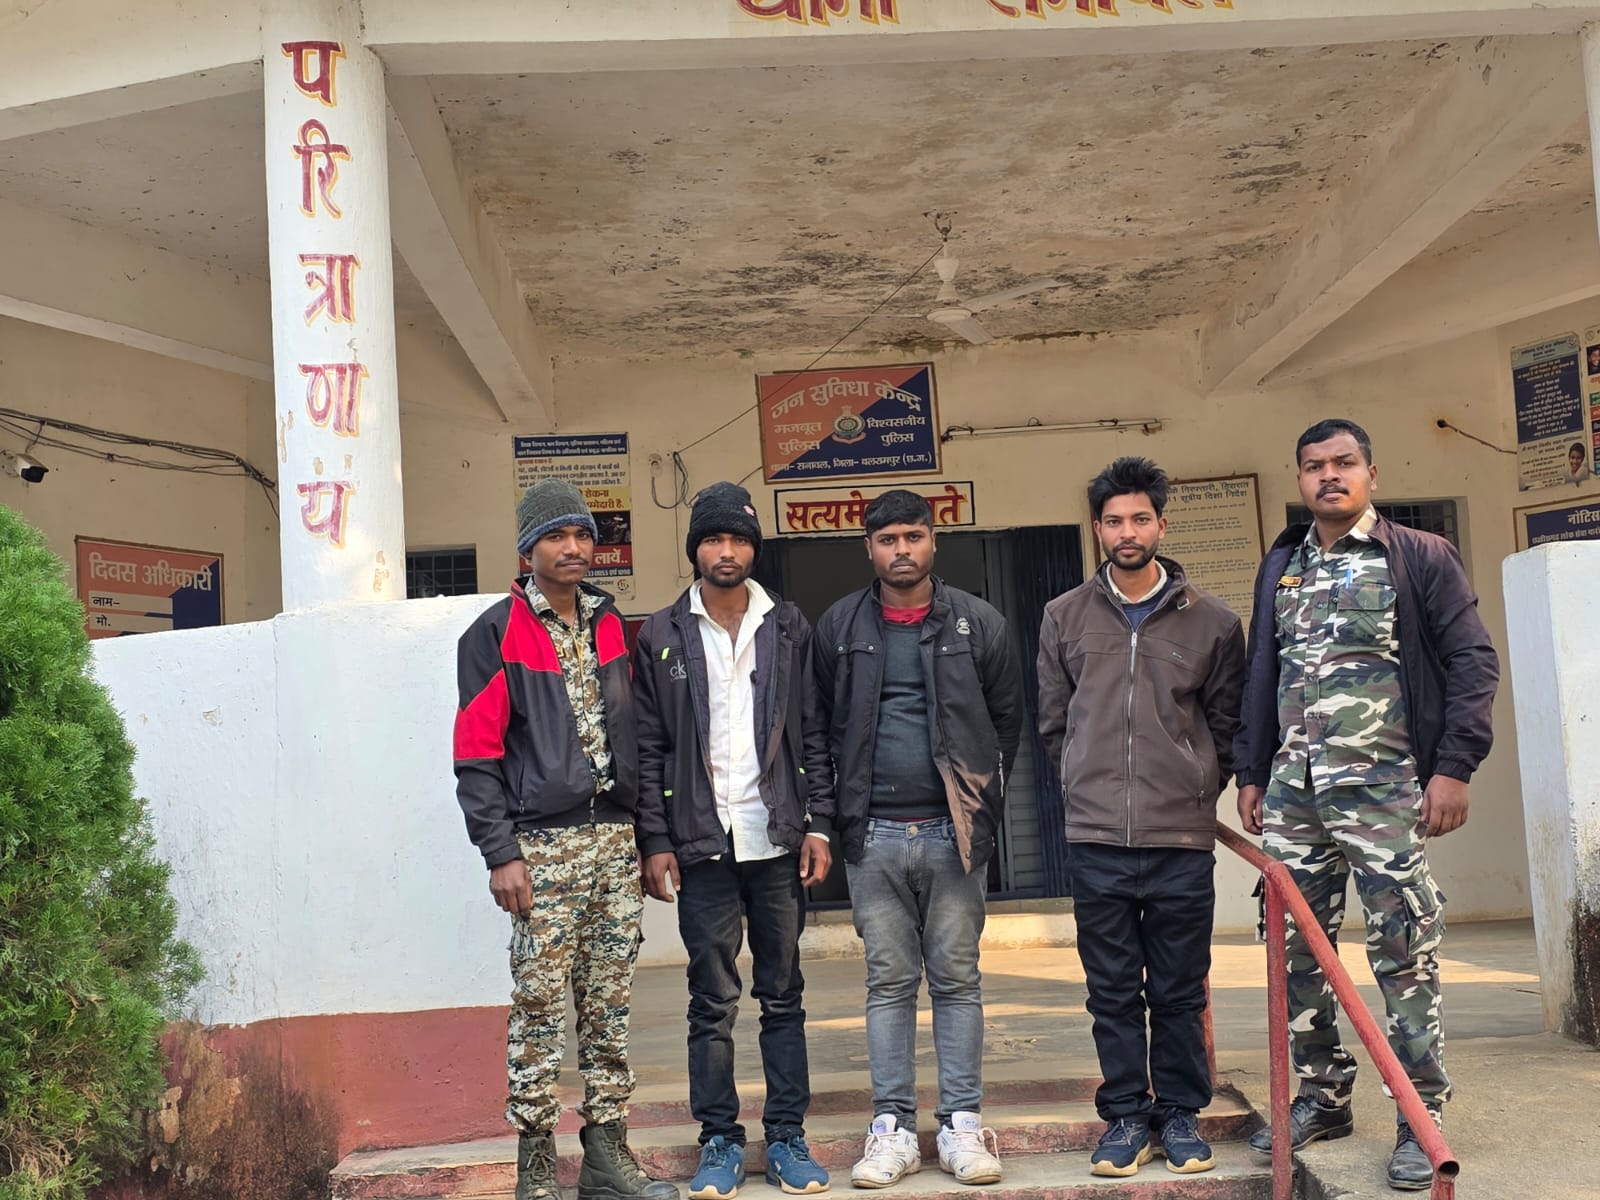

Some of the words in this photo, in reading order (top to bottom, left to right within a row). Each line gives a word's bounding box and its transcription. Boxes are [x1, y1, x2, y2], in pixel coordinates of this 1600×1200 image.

[771, 389, 806, 420] जन
[809, 376, 870, 407] सुविधा
[873, 379, 922, 412] केन्द्र
[866, 415, 926, 429] विश्वसनीय
[777, 440, 821, 456] पुलिस
[880, 431, 915, 446] पुलिस
[89, 551, 137, 584] दिवस
[142, 559, 213, 592] अधिकारी
[96, 614, 111, 627] मो.
